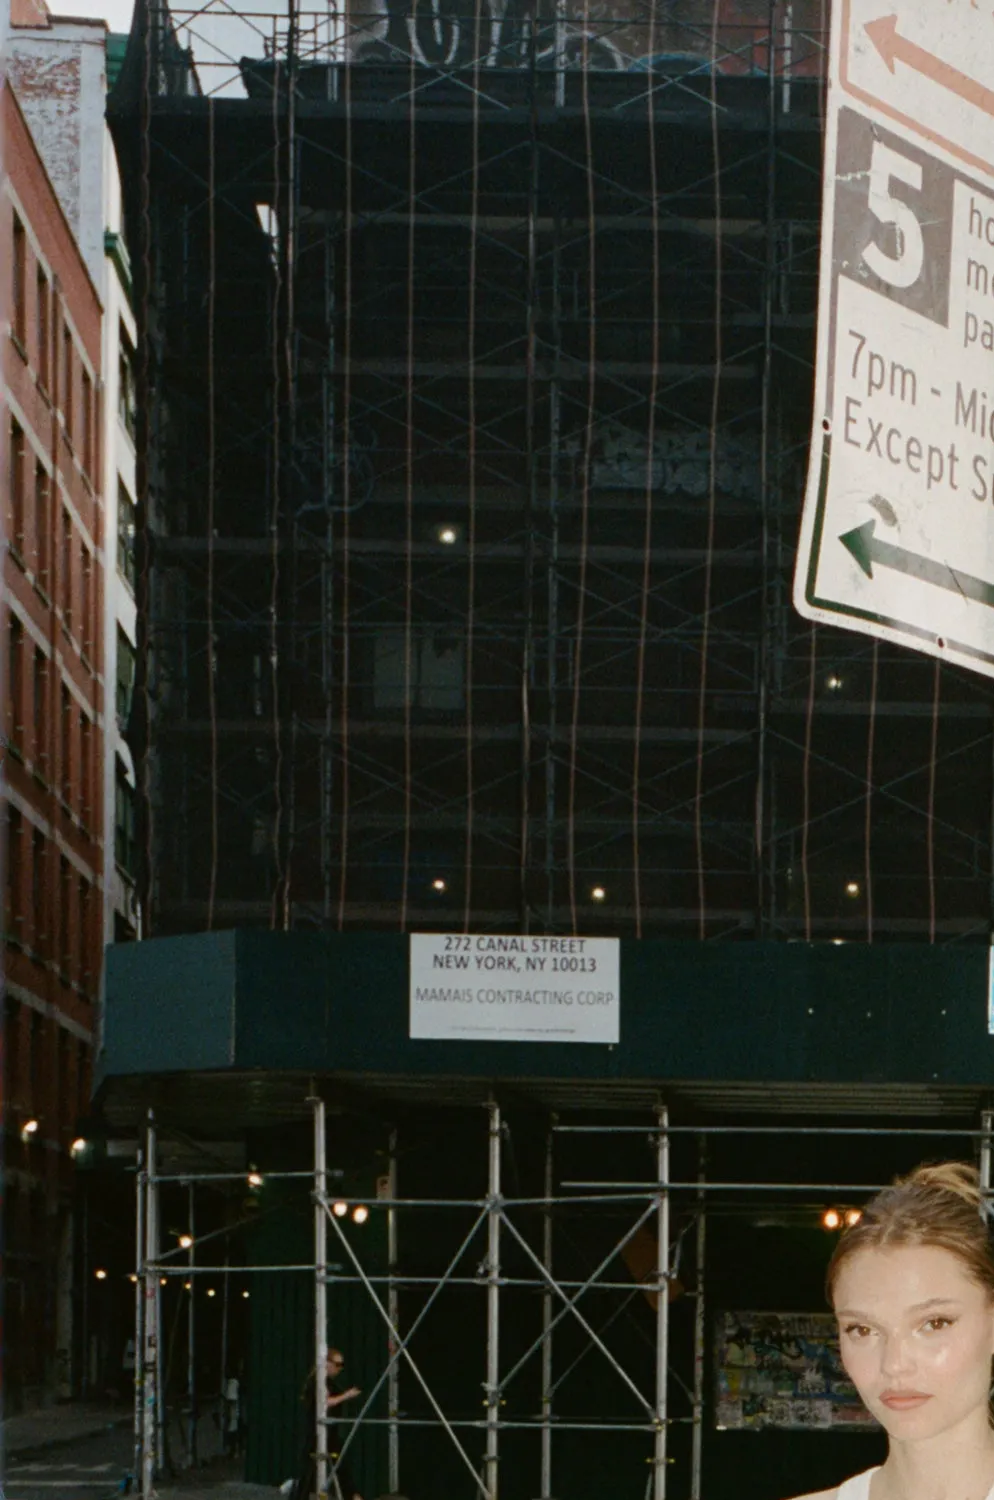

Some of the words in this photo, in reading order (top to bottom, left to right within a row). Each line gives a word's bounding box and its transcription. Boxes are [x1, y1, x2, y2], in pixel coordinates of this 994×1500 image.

[861, 139, 926, 289] 5
[848, 329, 917, 406] 7pm
[843, 396, 960, 490] Except
[432, 954, 469, 970] NEW
[475, 955, 521, 973] YORK,
[525, 956, 546, 971] NY
[551, 957, 597, 973] 10013
[443, 936, 472, 952] 272
[475, 937, 527, 953] CANAL
[531, 939, 587, 954] STREET
[415, 986, 473, 1004] MAMAIS
[476, 989, 574, 1006] CONTRACTING
[577, 991, 615, 1006] CORP
